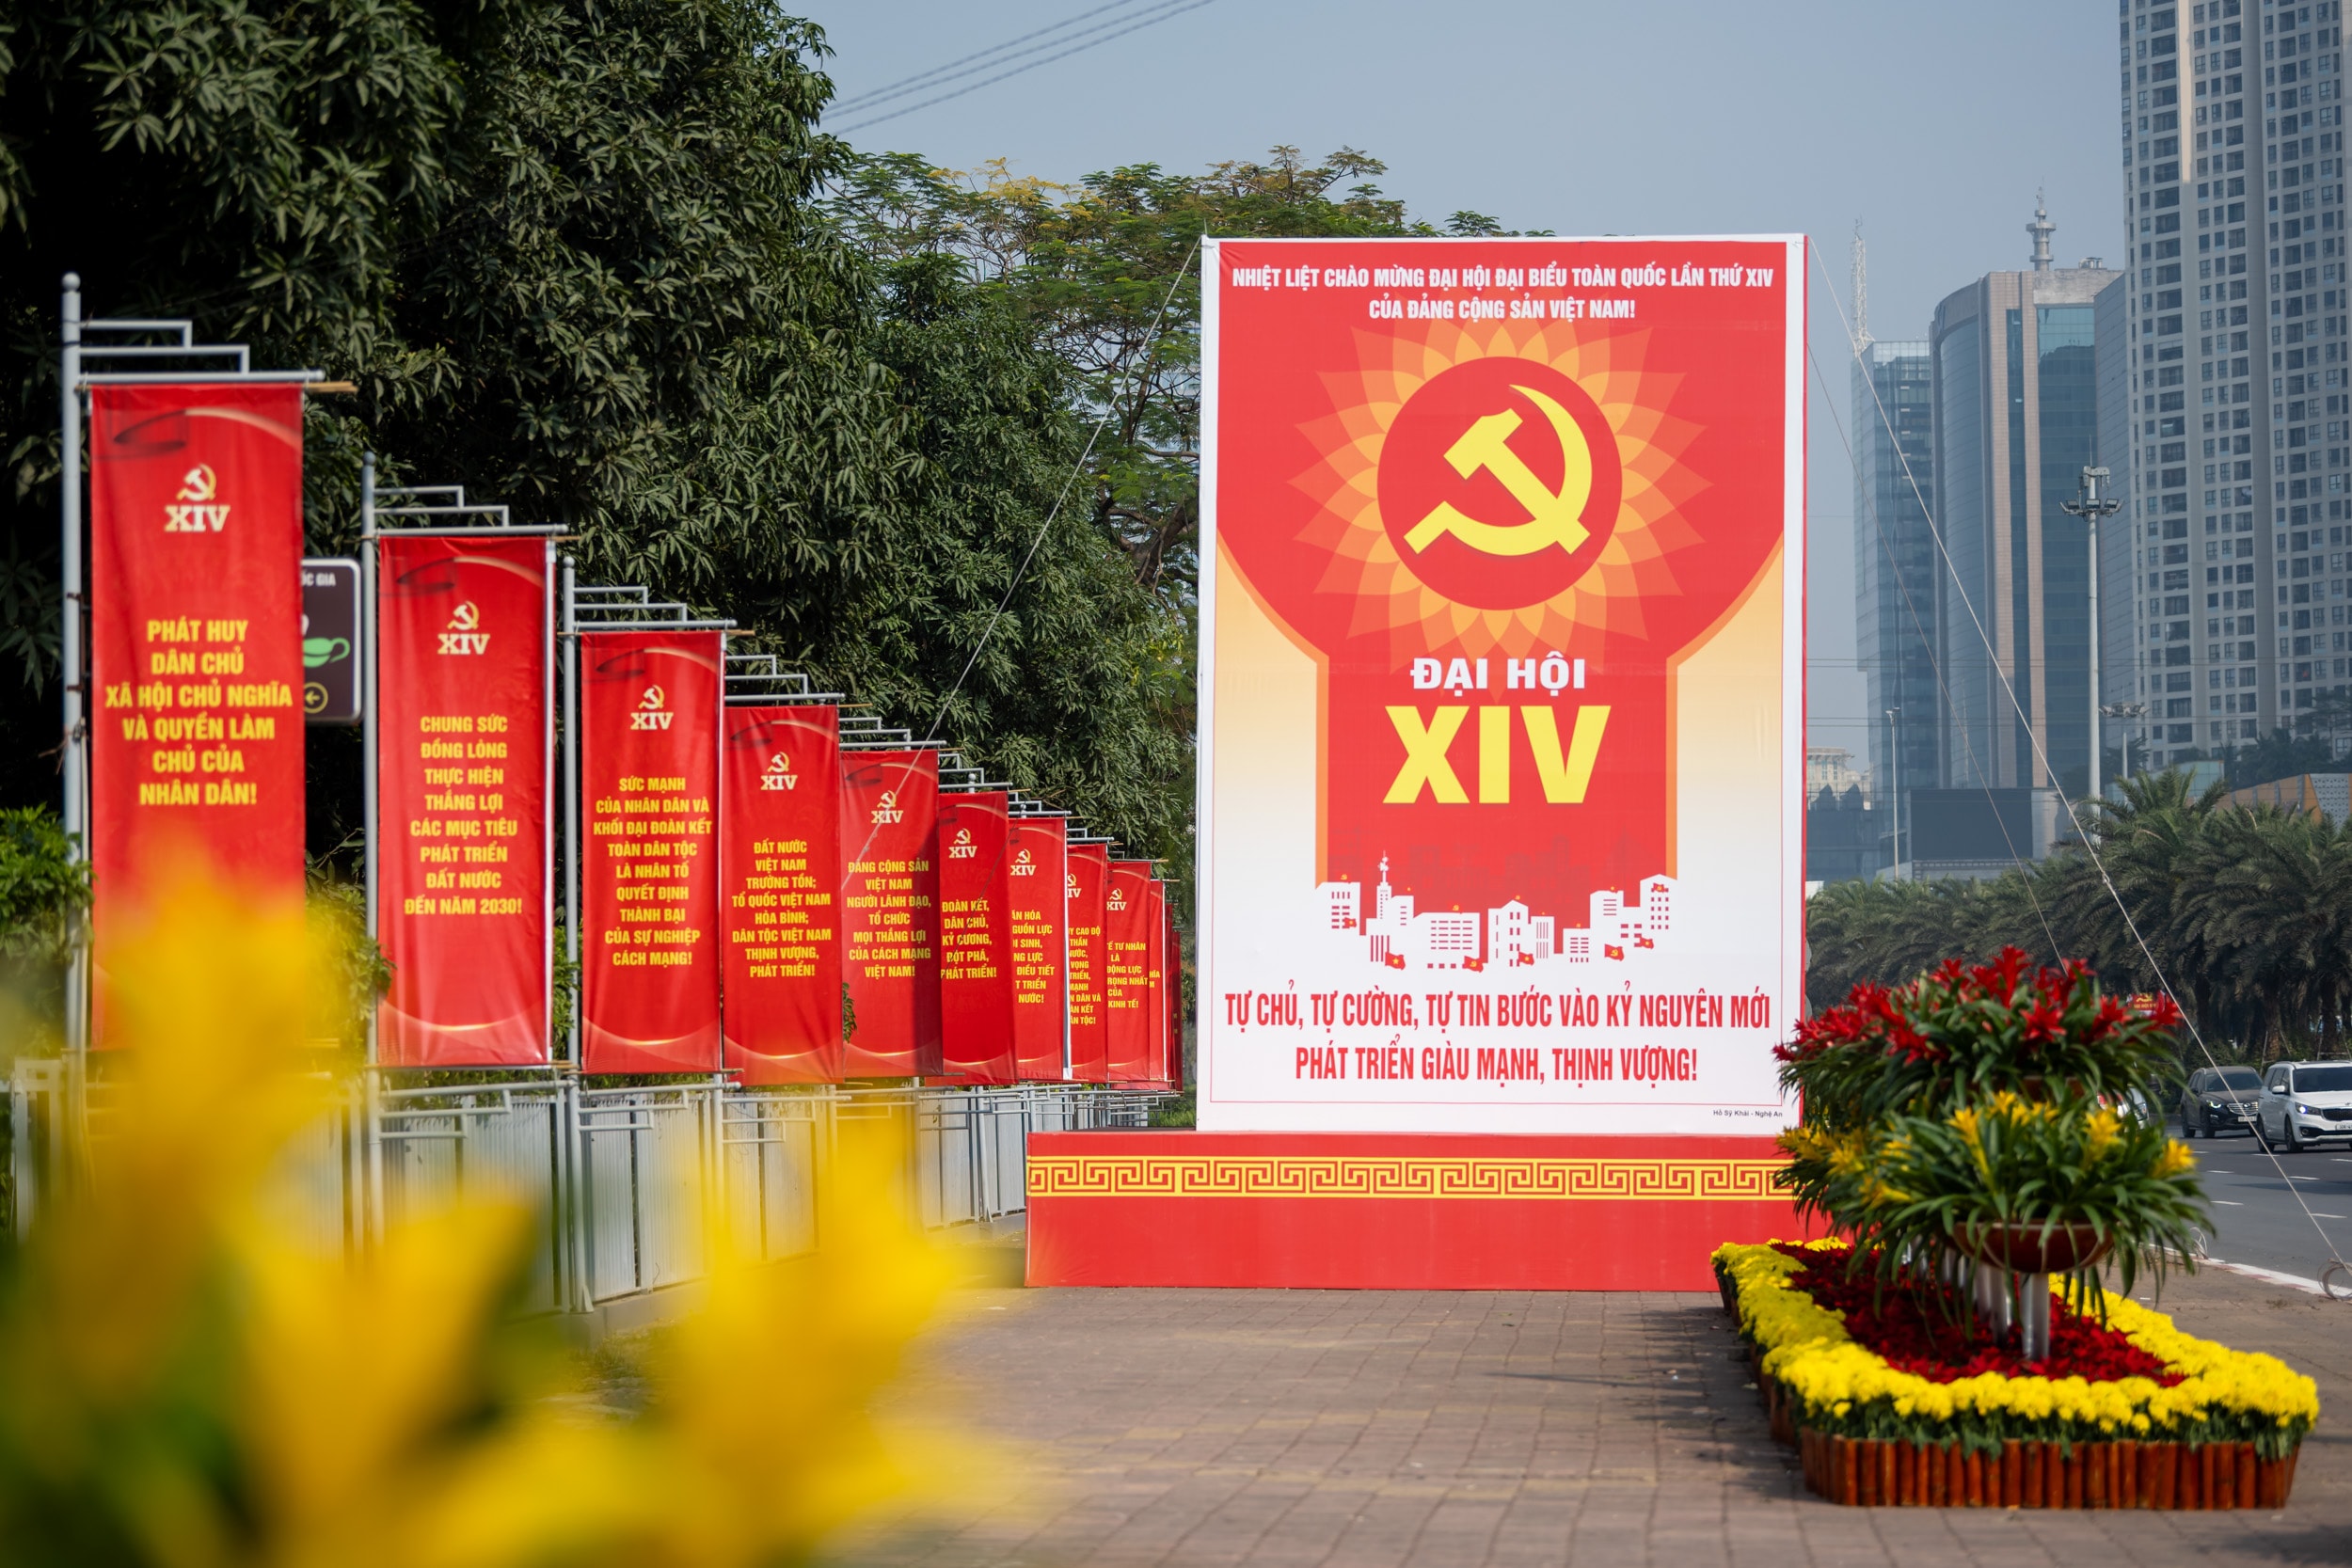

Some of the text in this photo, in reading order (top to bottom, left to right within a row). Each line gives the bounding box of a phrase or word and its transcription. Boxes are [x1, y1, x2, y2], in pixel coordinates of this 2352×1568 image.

[1232, 261, 1774, 292] NHIỆT LIỆT CHÀO MỪNG ĐẠI HỘI ĐẠI BIỂU TOÀN QUỐC LẦN THỨ XIV
[1369, 292, 1635, 324] CỦA ĐẢNG CỘNG SẢN VIỆT NAM!
[165, 504, 230, 532] XIV
[316, 573, 336, 586] GIA
[147, 615, 248, 642] PHÁT HUY
[437, 633, 491, 656] XIV
[151, 645, 245, 675] DÂN CHỦ
[1409, 650, 1585, 697] ĐẠI HỘI
[105, 677, 294, 712] XÃ HỘI CHỦ NGHĨA
[420, 713, 508, 733] CHUNG SỨC
[629, 711, 675, 730] XIV
[152, 743, 245, 773] CHỦ CỦA
[1382, 705, 1612, 804] XIV
[423, 765, 504, 788] THỰC HIỆN
[619, 775, 686, 794] SỨC MẠNH
[760, 774, 798, 791] XIV
[139, 779, 257, 805] NHÂN DÂN!
[596, 796, 710, 814] CỦA NHÂN DÂN VÀ
[870, 810, 904, 824] XIV
[409, 816, 517, 840] CÁC MỤC TIÊU
[420, 841, 508, 863] PHÁT TRIỂN
[607, 839, 698, 860] TOÀN DÂN TỘC
[753, 838, 807, 854] ĐẤT NƯỚC
[948, 846, 977, 858] XIV
[755, 857, 806, 874] VIỆT NAM
[1010, 865, 1036, 876] XIV
[865, 877, 912, 893] VIỆT NAM
[404, 894, 522, 915] ĐẾN NĂM 2030!
[846, 894, 931, 909] NGƯỜI LÃNH ĐẠO,
[942, 899, 968, 912] ĐOÀN
[619, 906, 686, 925] THÀNH BẠI
[755, 910, 809, 925] HÒA BÌNH;
[945, 916, 964, 929] DÂN
[1025, 910, 1041, 920] HÓA
[604, 926, 701, 947] CỦA SỰ NGHIỆP
[732, 927, 832, 944] DÂN TỘC VIỆT NAM
[942, 931, 955, 946] KỶ
[612, 949, 692, 968] CÁCH MẠNG!
[744, 947, 778, 962] THỊNH
[848, 945, 930, 961] CỦA CÁCH MẠNG
[750, 962, 778, 978] PHÁT
[864, 963, 914, 980] VIỆT NAM!
[1224, 978, 1771, 1034] TỰ CHỦ, TỰ CƯỜNG, TỰ TIN BƯỚC VÀO KỶ NGUYÊN MỚI
[1295, 1033, 1697, 1089] PHÁT TRIỂN GIÀU MẠNH, THỊNH VƯỢNG!
